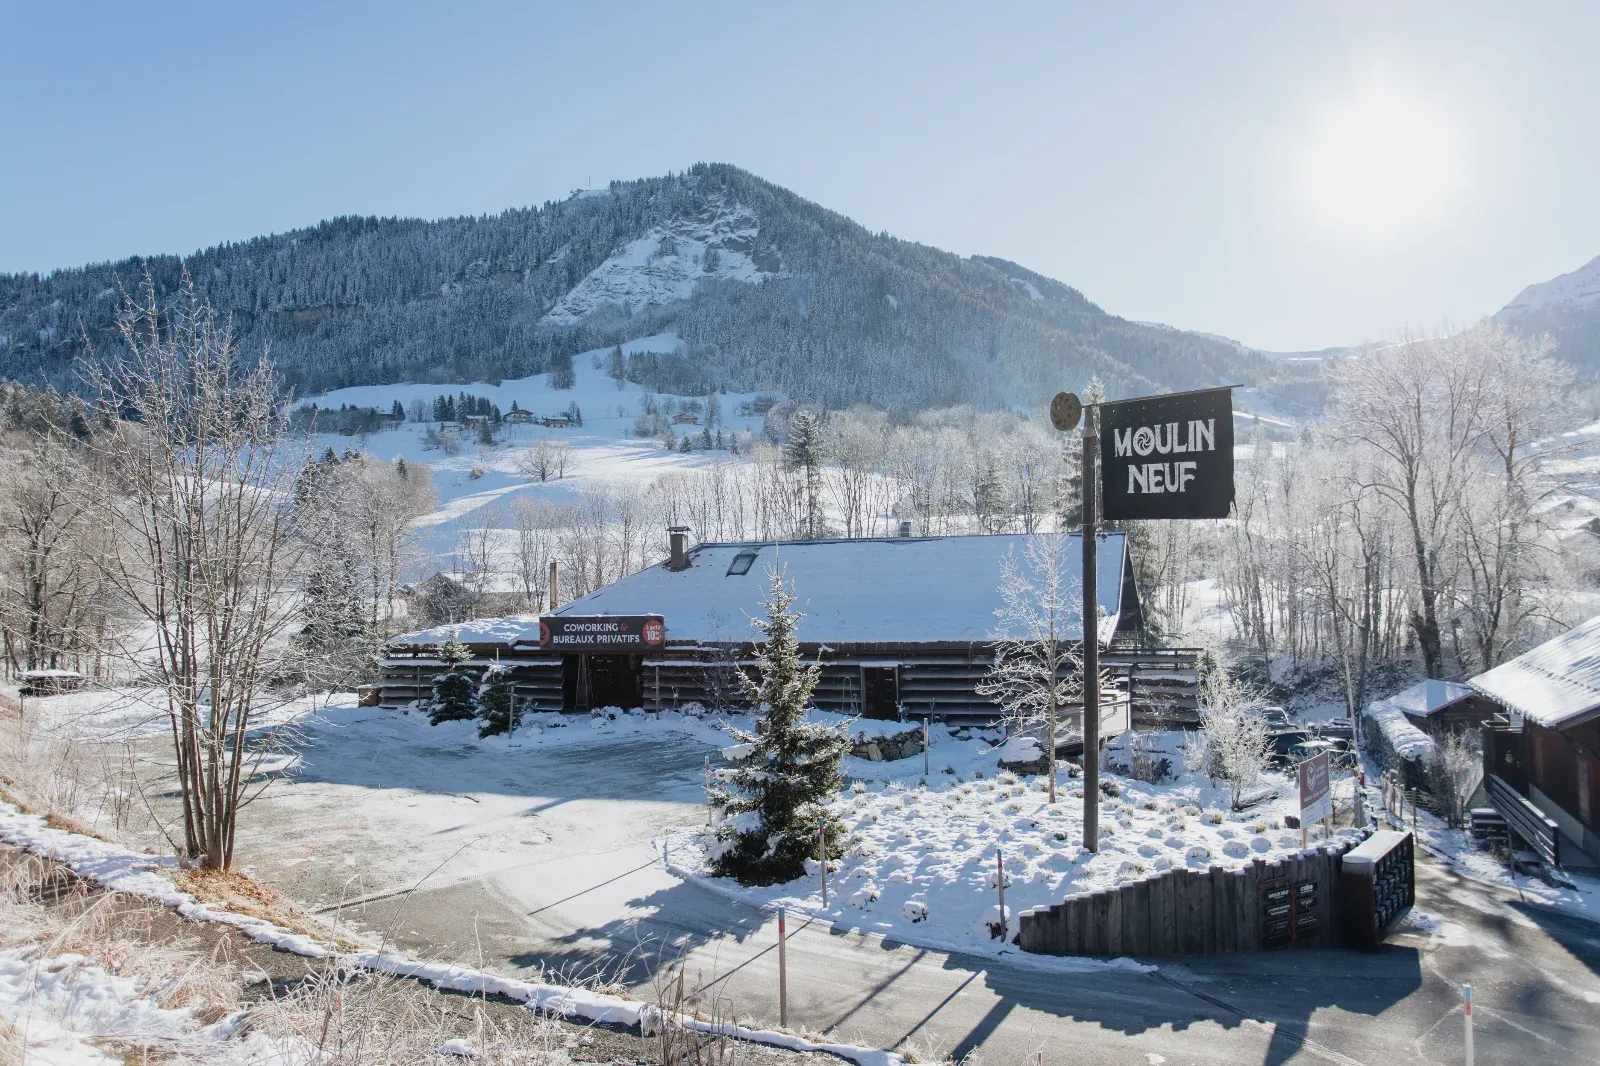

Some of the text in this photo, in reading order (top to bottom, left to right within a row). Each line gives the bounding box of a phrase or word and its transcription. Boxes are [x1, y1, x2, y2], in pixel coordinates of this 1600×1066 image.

[1113, 418, 1216, 457] MOULIN
[1126, 461, 1197, 494] NEUF
[564, 623, 618, 632] COWORKING
[553, 634, 640, 644] BUREAUX PRIVATIFS
